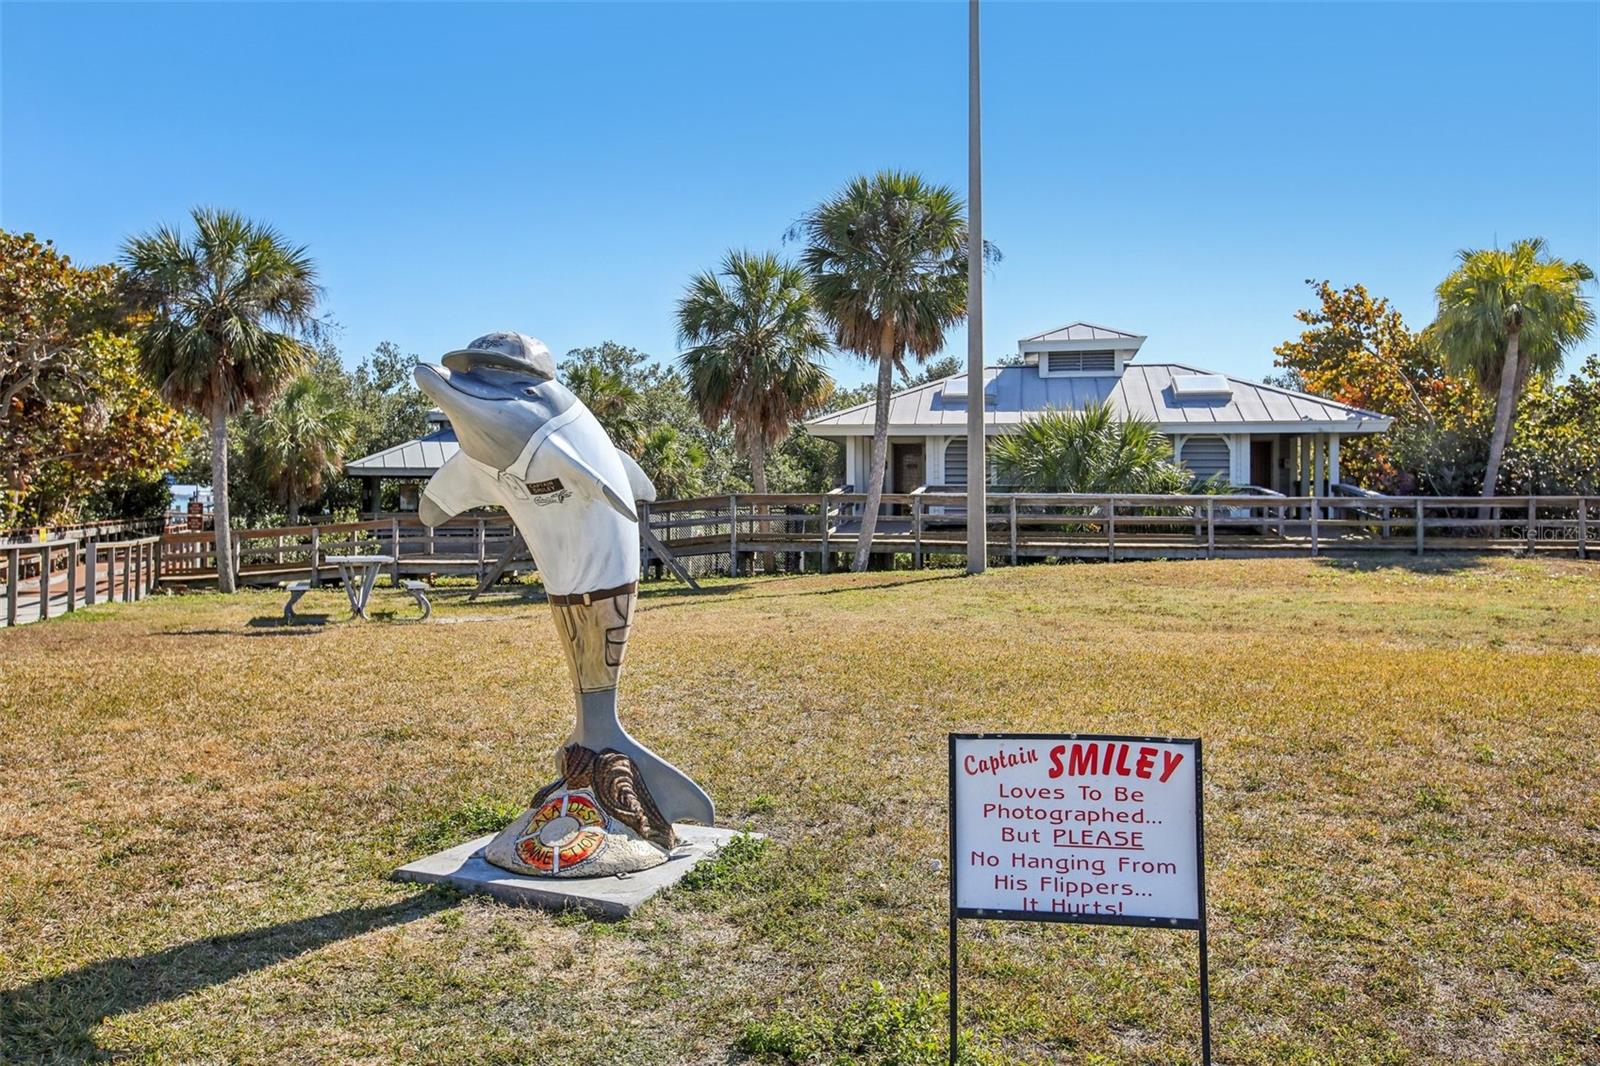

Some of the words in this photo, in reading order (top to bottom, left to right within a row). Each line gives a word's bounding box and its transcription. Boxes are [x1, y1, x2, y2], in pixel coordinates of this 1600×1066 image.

[964, 747, 1038, 776] Captain
[1049, 743, 1184, 782] SMILEY
[1000, 784, 1065, 800] Loves
[1078, 786, 1102, 801] To
[1115, 787, 1144, 802] Be
[984, 804, 1163, 825] Photographed...
[1002, 827, 1040, 843] But
[1054, 829, 1144, 848] PLEASE
[971, 851, 999, 867] No
[1012, 853, 1105, 875] Hanging
[1119, 857, 1176, 874] From
[995, 875, 1027, 891] His
[1041, 877, 1152, 897] Flippers...
[1023, 897, 1038, 912] It
[1052, 898, 1123, 916] Hurts!
